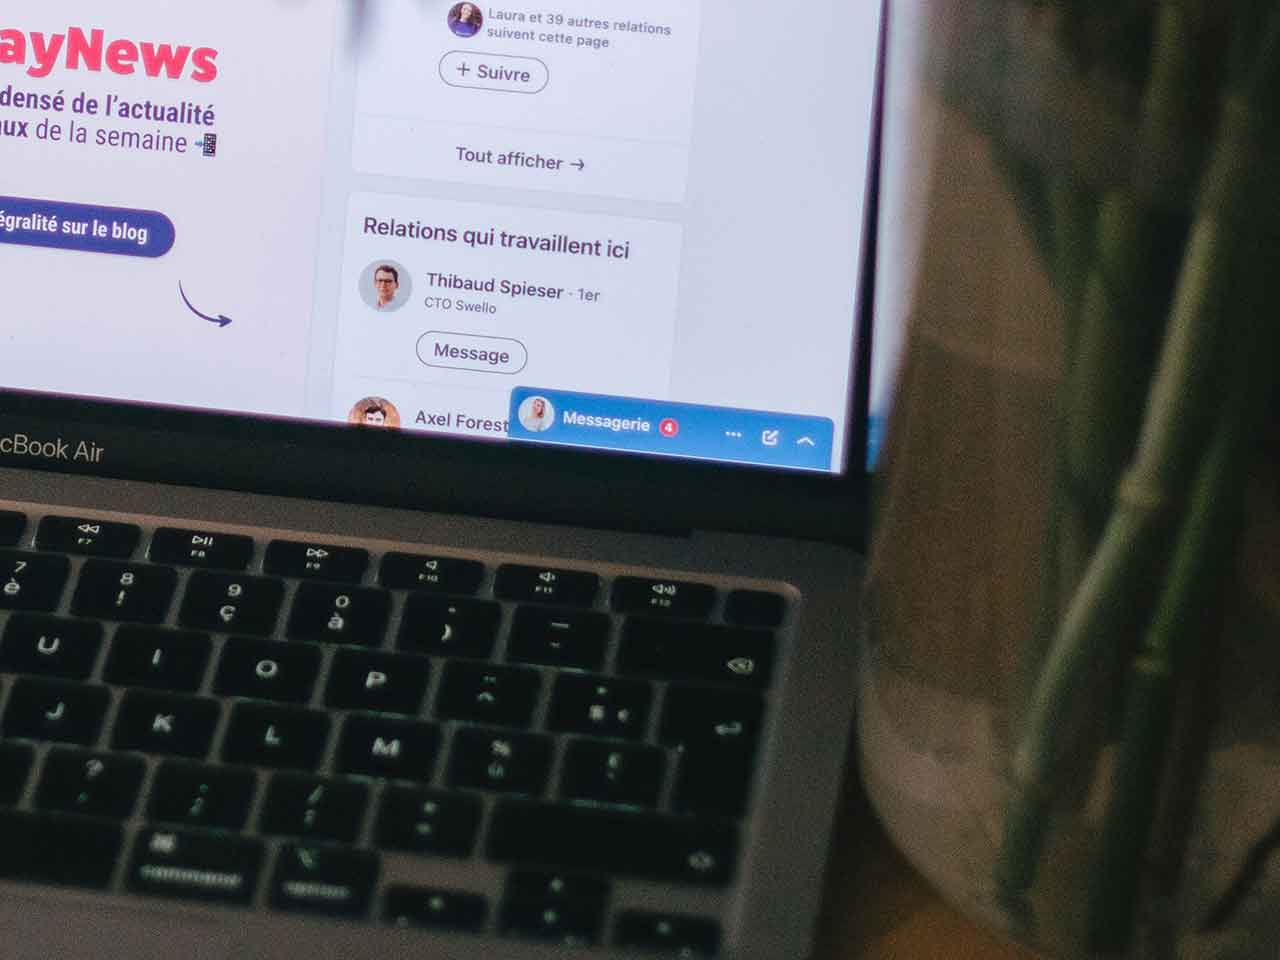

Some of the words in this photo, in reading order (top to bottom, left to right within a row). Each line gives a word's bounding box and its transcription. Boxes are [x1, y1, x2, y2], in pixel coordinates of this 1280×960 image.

[489, 8, 525, 23] Laura
[529, 11, 543, 24] et
[546, 13, 563, 26] 39
[567, 16, 609, 30] autres
[613, 18, 671, 35] relations
[487, 26, 535, 41] suivent
[539, 31, 572, 46] cette
[576, 36, 609, 50] page
[477, 64, 530, 83] Suivre
[72, 91, 98, 115] de
[36, 118, 61, 141] de
[70, 121, 87, 143] la
[96, 128, 188, 153] semaine
[456, 147, 492, 164] Tout
[497, 151, 563, 171] afficher
[62, 219, 88, 236] sur
[93, 219, 107, 238] le
[112, 221, 148, 244] blog
[363, 217, 457, 243] Relations
[463, 228, 494, 248] qui
[500, 231, 601, 257] travaillent
[607, 240, 630, 260] ici
[426, 273, 494, 292] Thibaud
[500, 279, 564, 300] Spieser
[578, 287, 601, 303] 1er
[425, 296, 451, 310] CTO
[455, 300, 497, 315] Swello
[434, 342, 510, 365] Message
[415, 410, 451, 427] Axel
[563, 410, 650, 433] Messagerie
[73, 440, 105, 463] Air
[37, 636, 60, 655] U
[256, 659, 279, 678] O
